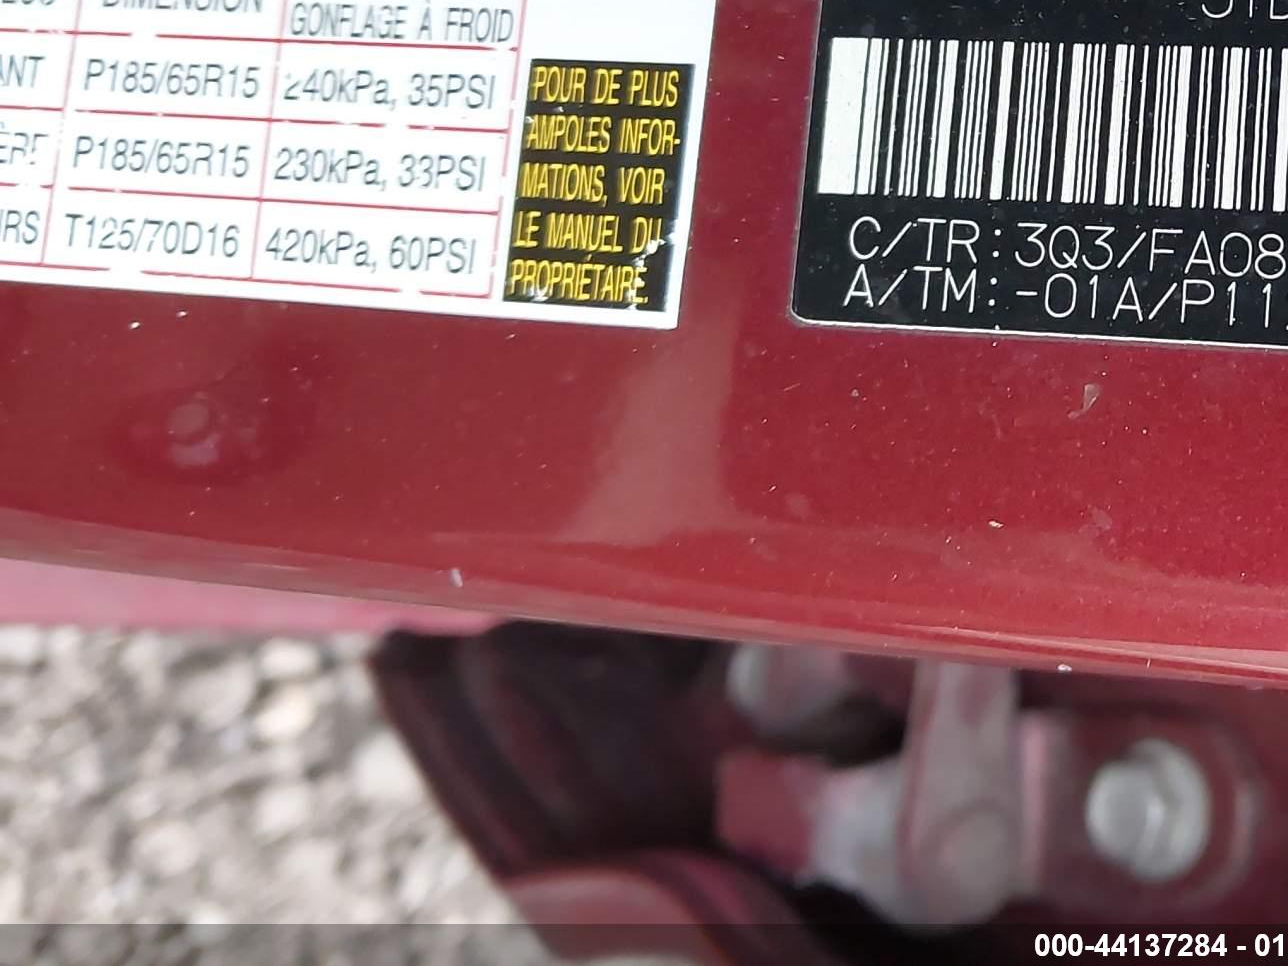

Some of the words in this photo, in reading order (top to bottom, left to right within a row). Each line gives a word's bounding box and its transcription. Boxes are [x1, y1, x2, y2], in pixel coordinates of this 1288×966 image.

[289, 2, 409, 39] GONFLAGE
[445, 7, 515, 43] FROID
[82, 57, 261, 100] P185/65R15
[408, 73, 496, 111] 35PSI
[533, 66, 587, 103] POUR
[592, 68, 623, 105] DE
[629, 69, 680, 107] PLUS
[72, 134, 251, 179] P185/65R15
[527, 114, 612, 153] AMPOLES
[619, 118, 682, 155] INFOR-
[273, 146, 387, 192] 230kPa,
[397, 154, 486, 193] 33PSI
[521, 162, 609, 207] MATIONS,
[617, 166, 666, 205] VOIR
[64, 213, 241, 259] T125/70D16
[264, 226, 377, 273] 420kPa,
[389, 235, 477, 275] 60PSI
[513, 210, 542, 248] LE
[547, 212, 624, 253] MANUEL
[630, 216, 663, 254] DU
[848, 216, 1003, 266] C/TR:
[1015, 221, 1288, 278] 3Q3/FA08
[841, 265, 1000, 315] A/TM:
